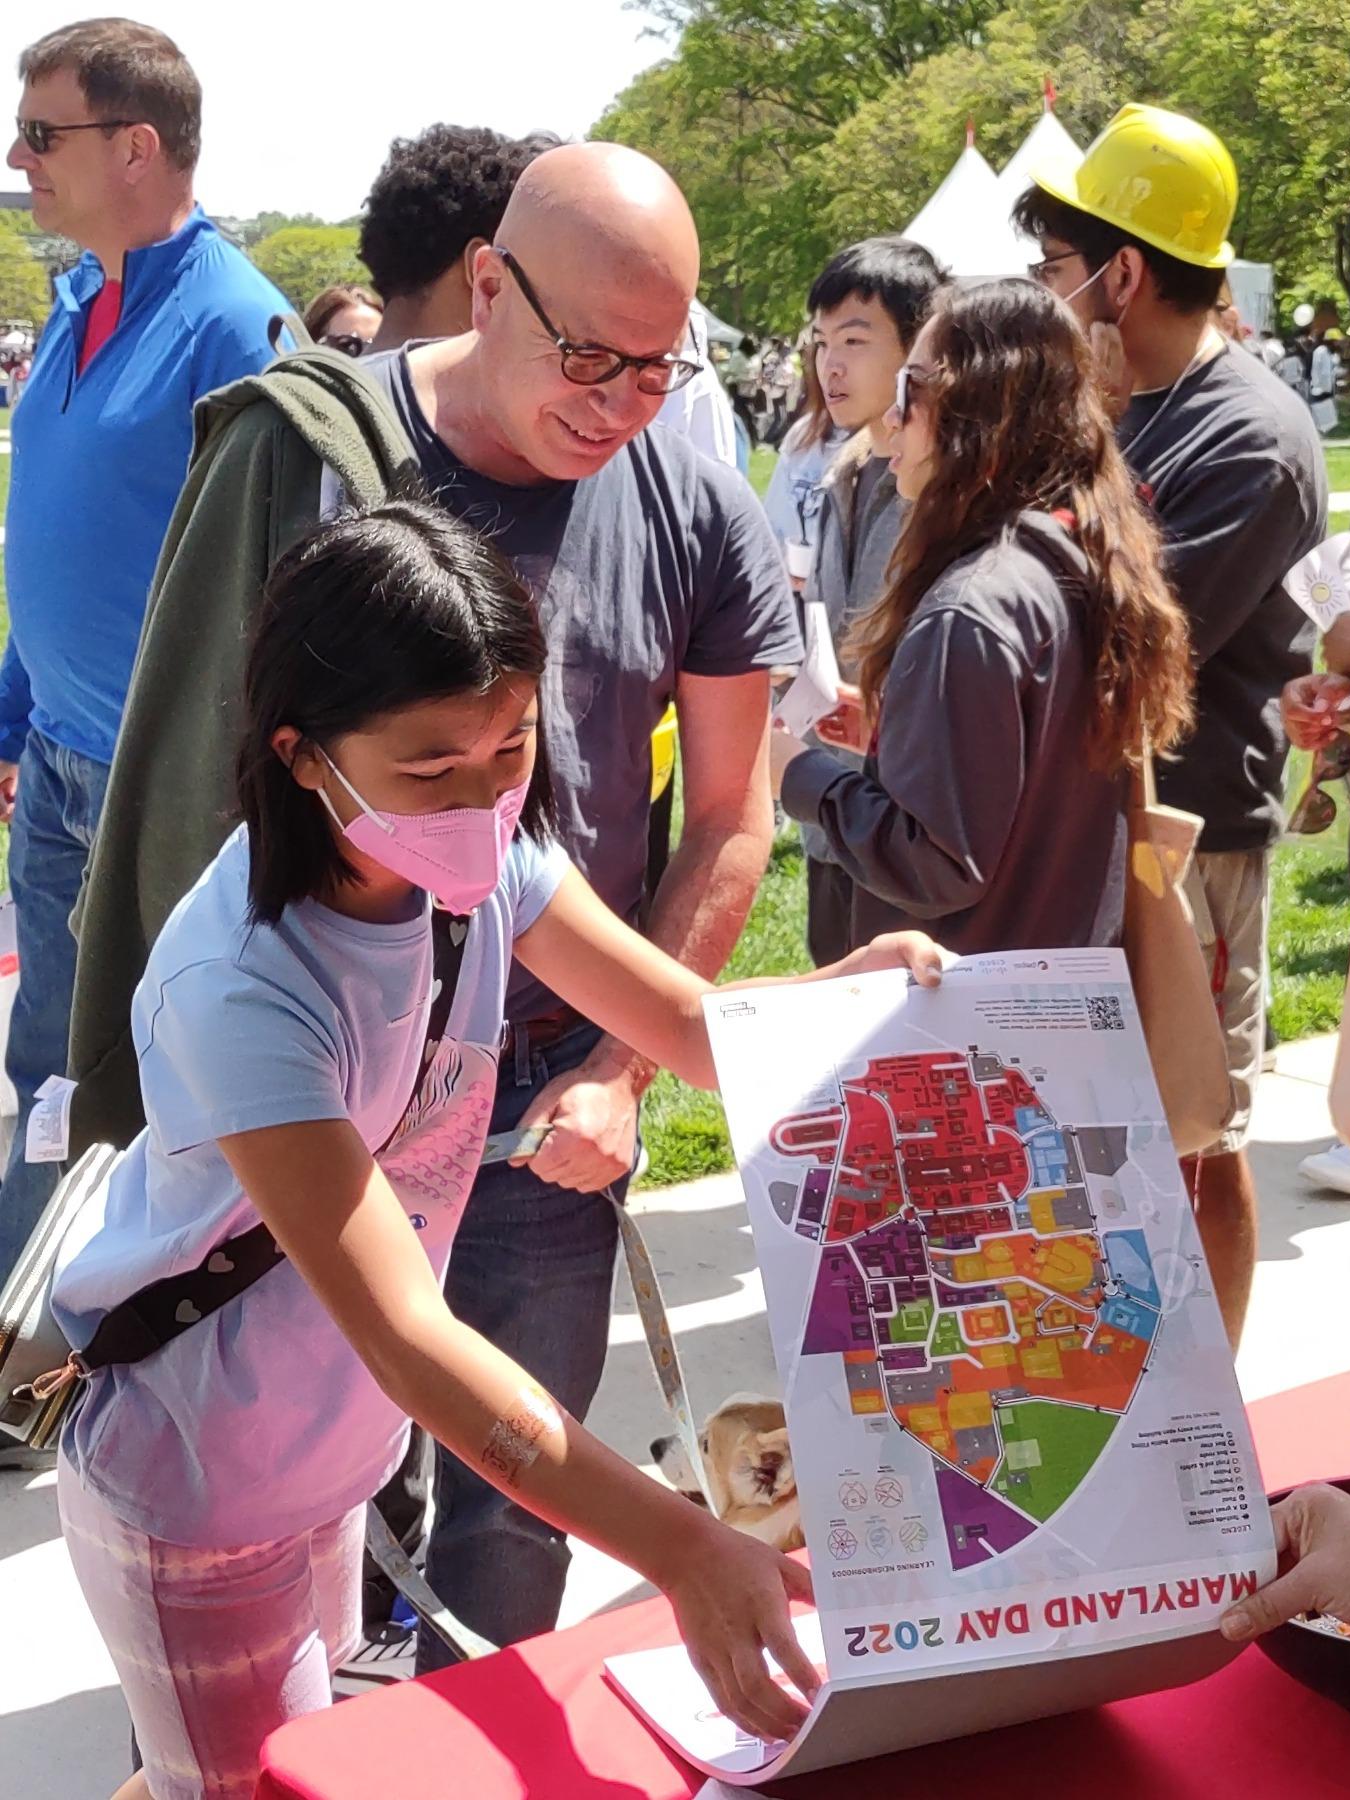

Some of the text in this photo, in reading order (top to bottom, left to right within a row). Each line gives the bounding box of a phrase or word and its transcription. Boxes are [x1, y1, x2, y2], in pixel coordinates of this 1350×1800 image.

[1221, 1525, 1251, 1534] LEGEND
[831, 1561, 934, 1578] LEARNING NEIGHBORHOODS
[844, 1570, 1257, 1657] MARYLAND DAY 2022
